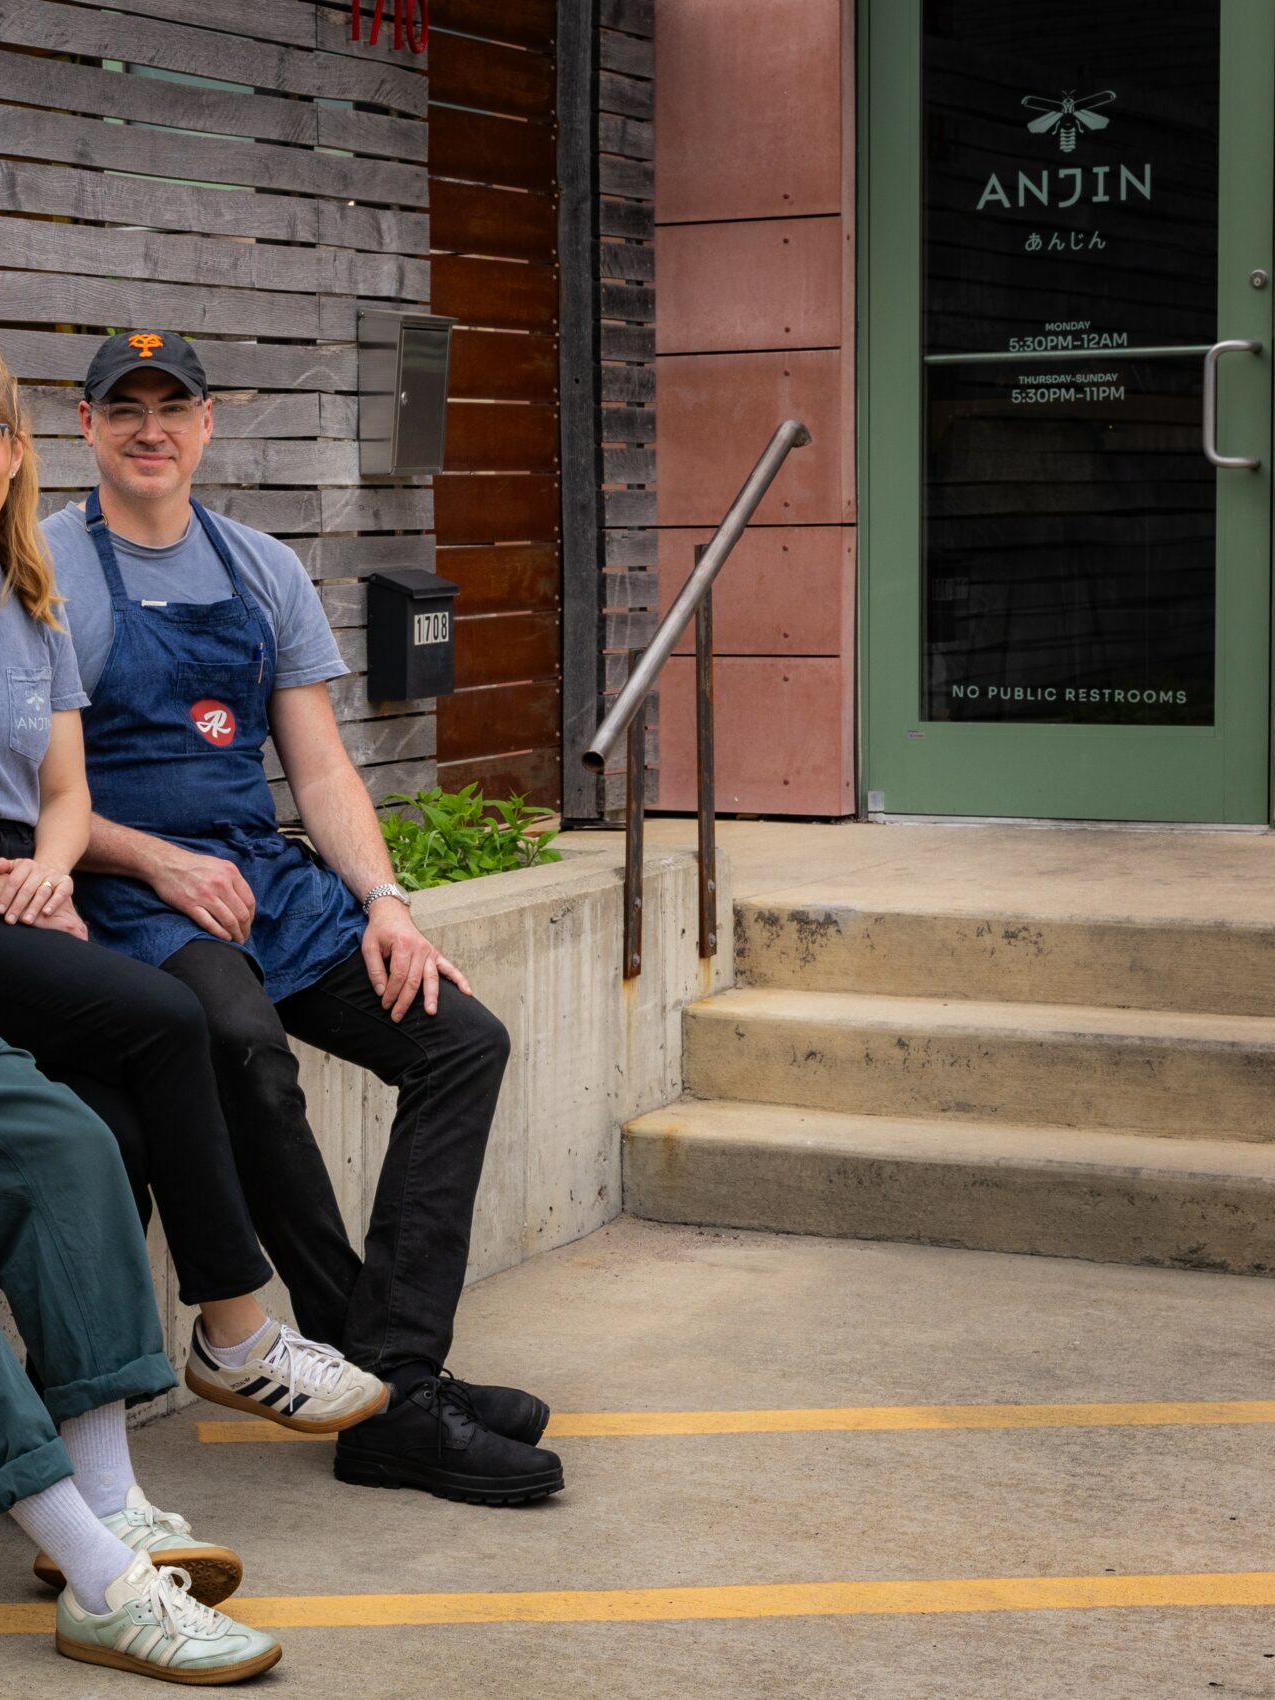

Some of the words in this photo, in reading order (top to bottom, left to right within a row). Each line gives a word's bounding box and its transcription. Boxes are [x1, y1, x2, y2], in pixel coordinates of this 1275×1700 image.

[976, 163, 1152, 210] ANJIN
[1024, 230, 1107, 252] あんじん
[1044, 321, 1091, 332] MONDAY
[1008, 332, 1128, 352] 5:30PM-12AM
[1018, 373, 1118, 385] THURSDAY-SUNDAY
[1011, 386, 1125, 404] 5:30PM-11PM
[416, 613, 448, 643] 1708
[952, 684, 980, 699] NO
[988, 686, 1057, 701] PUBLIC
[1065, 689, 1187, 705] RESTROOMS
[17, 716, 51, 732] ANJI
